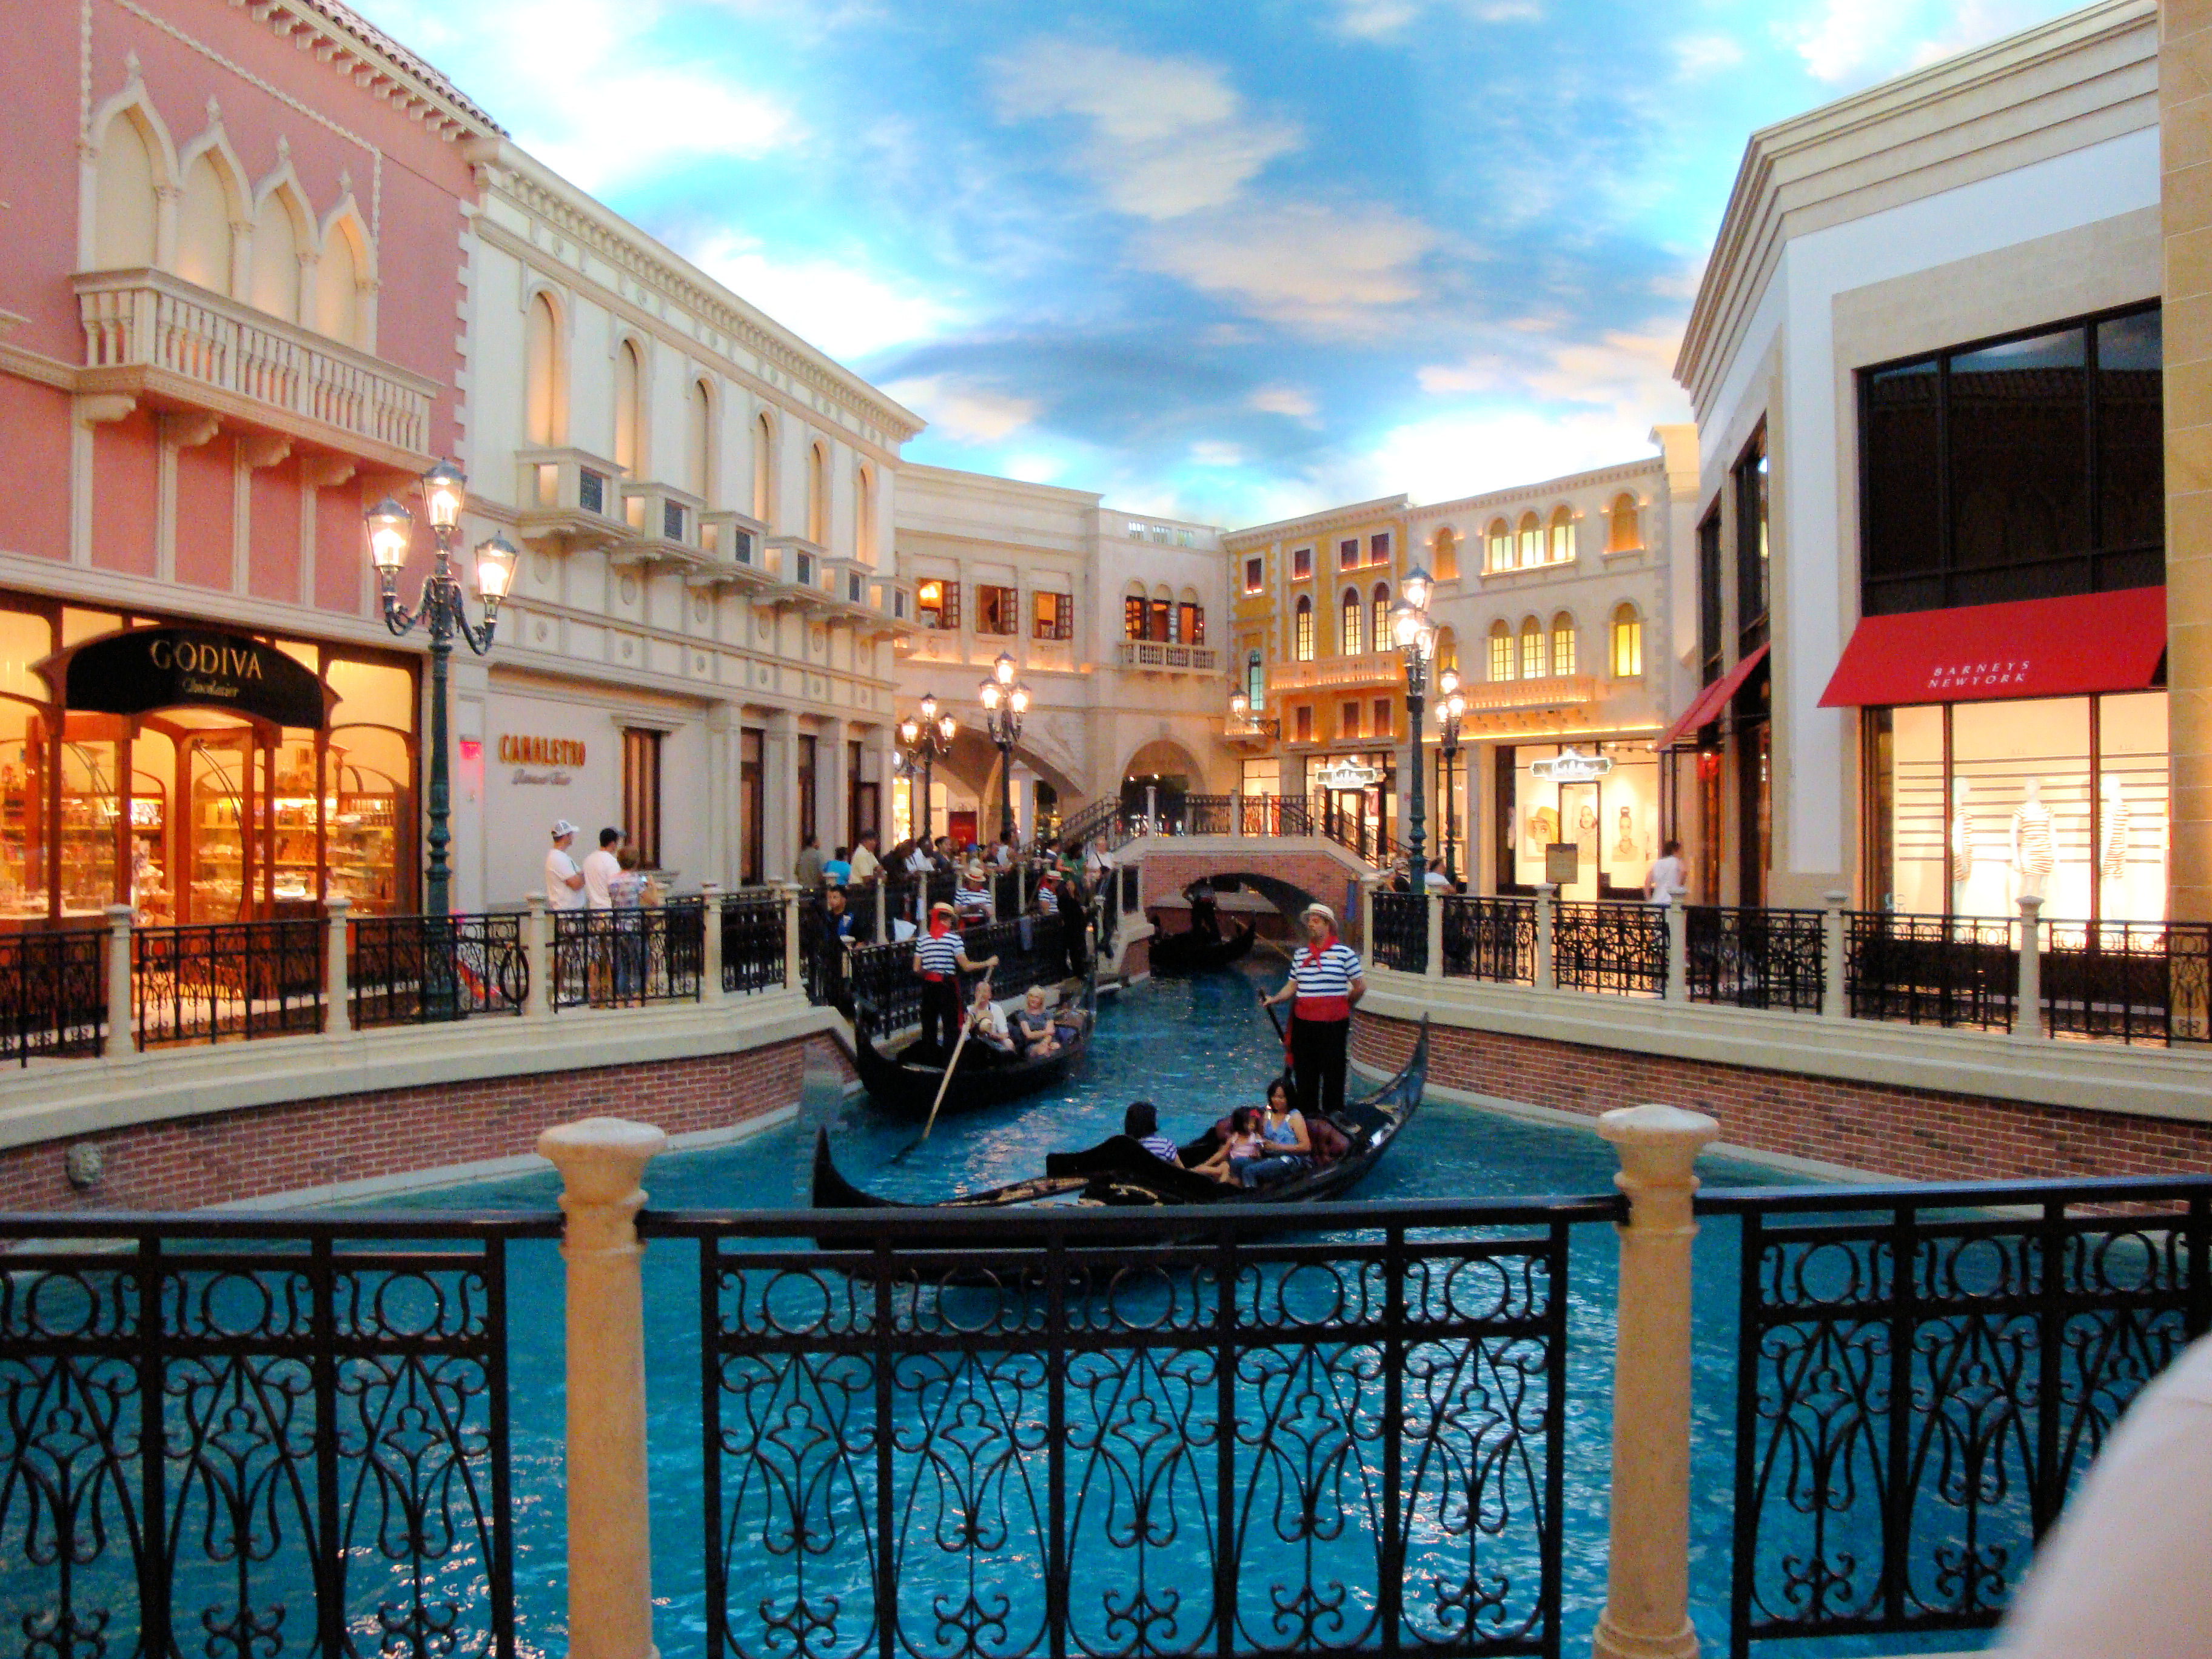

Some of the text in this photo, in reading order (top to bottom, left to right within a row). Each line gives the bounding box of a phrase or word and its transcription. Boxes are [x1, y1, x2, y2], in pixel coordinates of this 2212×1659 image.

[150, 640, 262, 680] GODIVA
[1933, 660, 2029, 677] BARNEYS
[498, 734, 586, 768] CANALETTO
